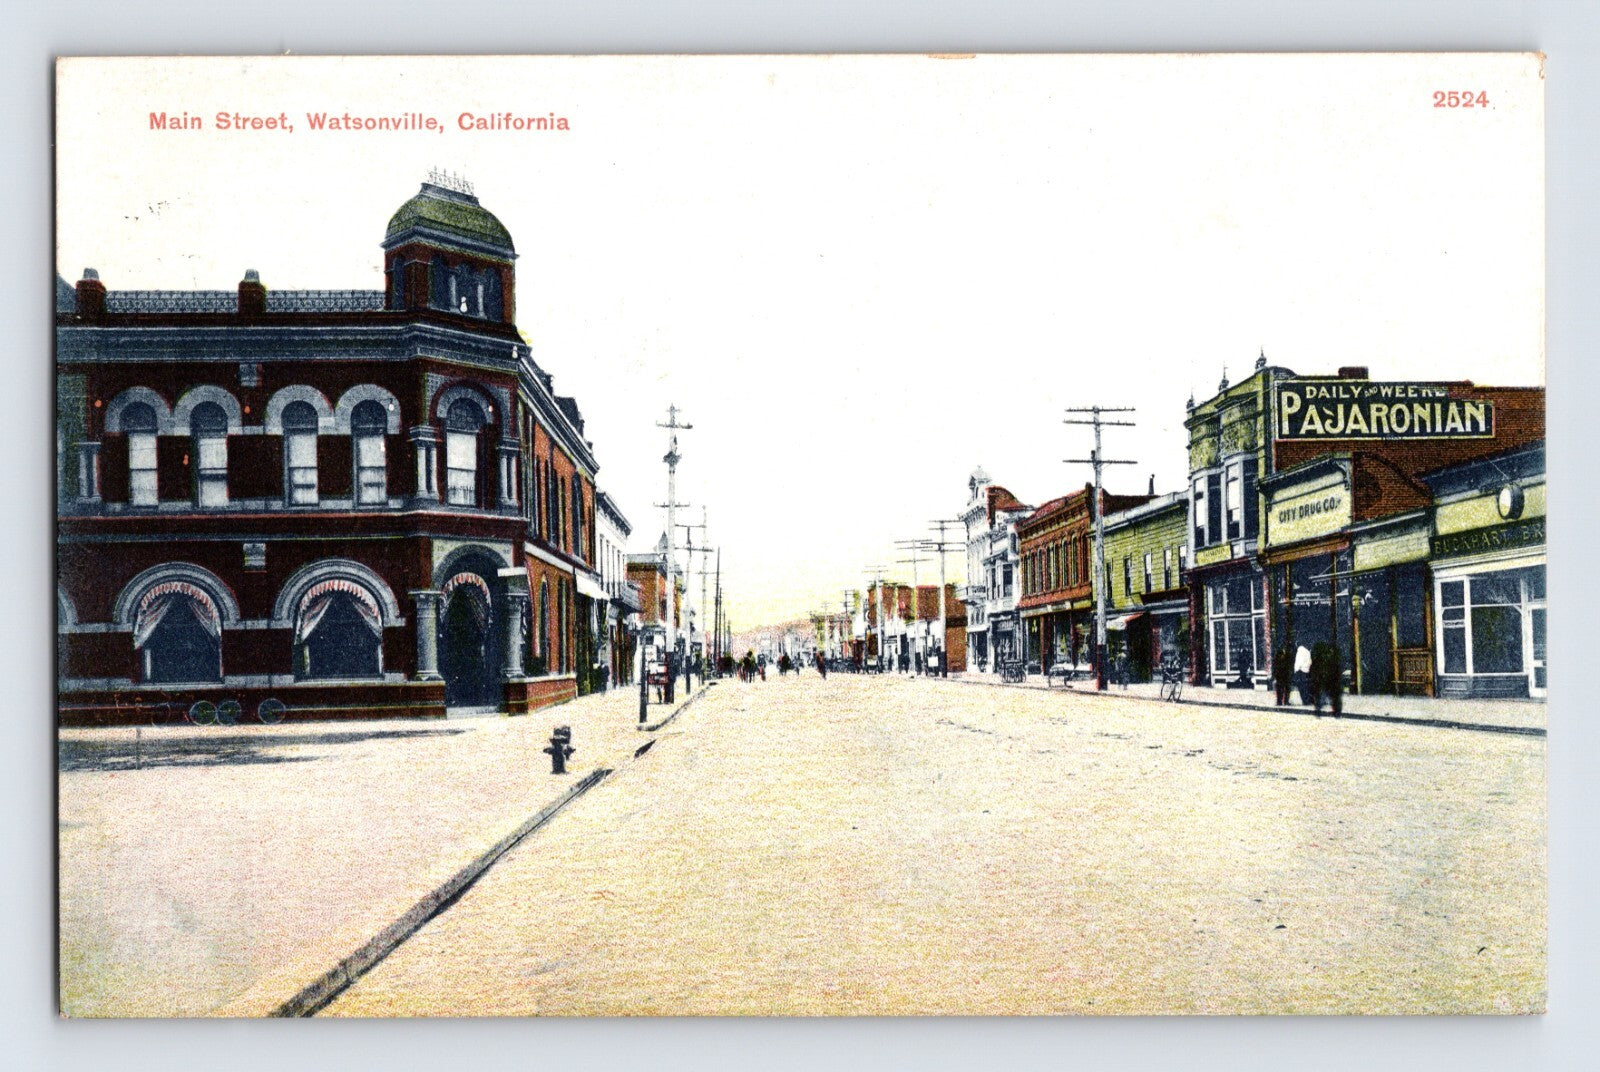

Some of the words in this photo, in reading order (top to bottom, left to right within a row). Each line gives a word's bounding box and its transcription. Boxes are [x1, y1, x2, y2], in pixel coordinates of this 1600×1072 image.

[1305, 385, 1361, 399] DAILY
[1380, 385, 1447, 398] WEEKL
[1281, 391, 1486, 435] PAJARONIAN
[1279, 507, 1297, 523] CITY
[1299, 501, 1322, 518] DRUG
